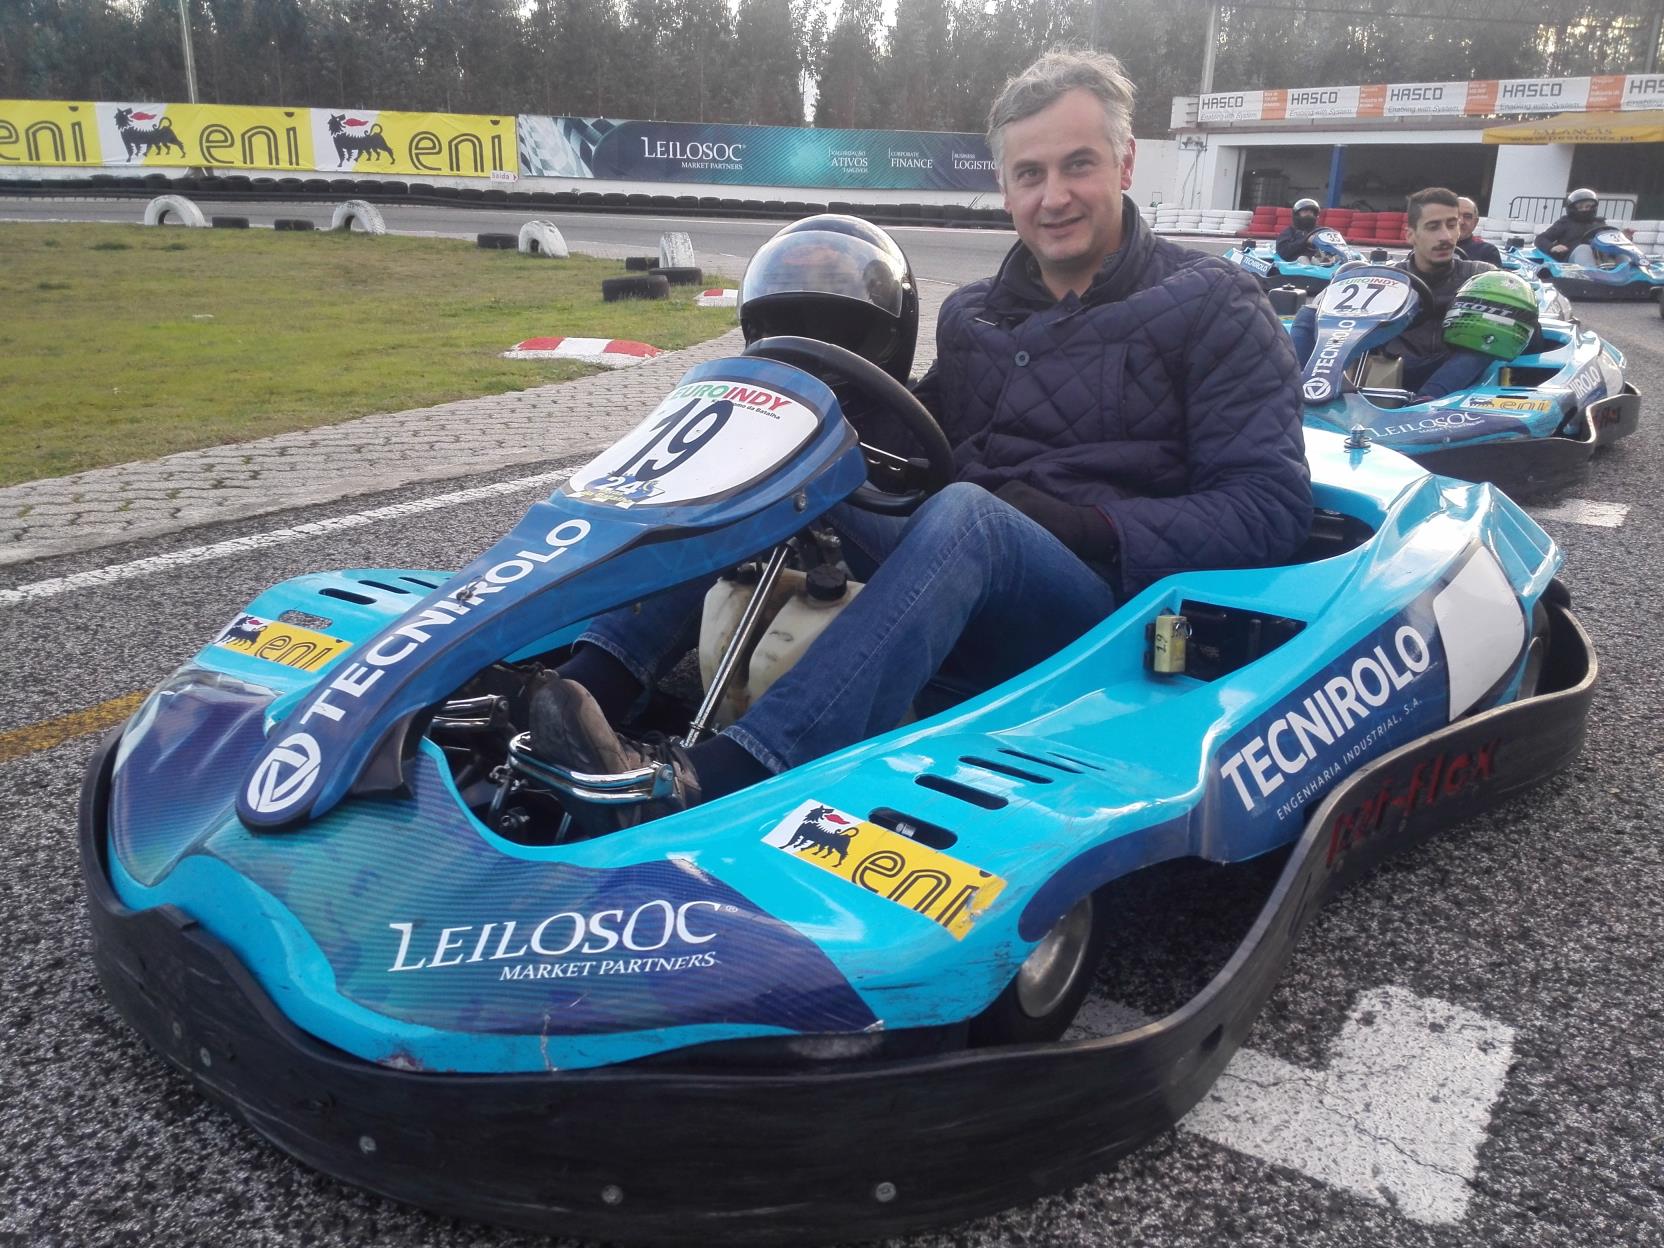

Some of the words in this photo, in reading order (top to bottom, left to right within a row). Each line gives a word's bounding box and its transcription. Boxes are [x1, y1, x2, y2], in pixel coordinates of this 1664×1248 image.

[1291, 91, 1339, 105] HASCO
[1390, 87, 1443, 101] HASCO
[1503, 83, 1562, 98] HASCO
[1629, 79, 1664, 94] HAS
[1202, 95, 1244, 110] HASCO
[0, 106, 86, 161] eni
[199, 112, 299, 166] eni
[408, 120, 503, 172] eni
[640, 136, 743, 161] LEILOSOC
[681, 161, 708, 169] MARKET
[710, 162, 743, 170] PARTNERS
[831, 157, 868, 167] ATIVOS
[891, 158, 933, 169] FINANCE
[954, 160, 996, 170] LOGISTIC
[1243, 256, 1268, 272] TECNIROLO
[1334, 284, 1386, 310] 27
[1452, 301, 1513, 316] SCOTT
[1311, 320, 1356, 376] TECNIROLO
[1569, 366, 1600, 400] IROLO
[671, 384, 792, 411] EUROINDY
[1500, 400, 1549, 411] eni
[755, 407, 781, 420] Batalha
[1370, 412, 1481, 437] LEILOSOC
[613, 398, 734, 482] 19
[594, 476, 646, 494] 24
[300, 518, 592, 725] TECNIROLO
[255, 635, 344, 669] eni
[1220, 625, 1430, 811] TECNIROLO
[1276, 761, 1341, 821] ENGENHARIA
[1342, 716, 1402, 767] INDUSTRIAL,
[1403, 698, 1423, 715] S.A.
[851, 849, 993, 927] eni
[387, 899, 721, 972] LEILOSOC
[500, 961, 596, 981] MARKET
[599, 951, 718, 976] PARTNERS
